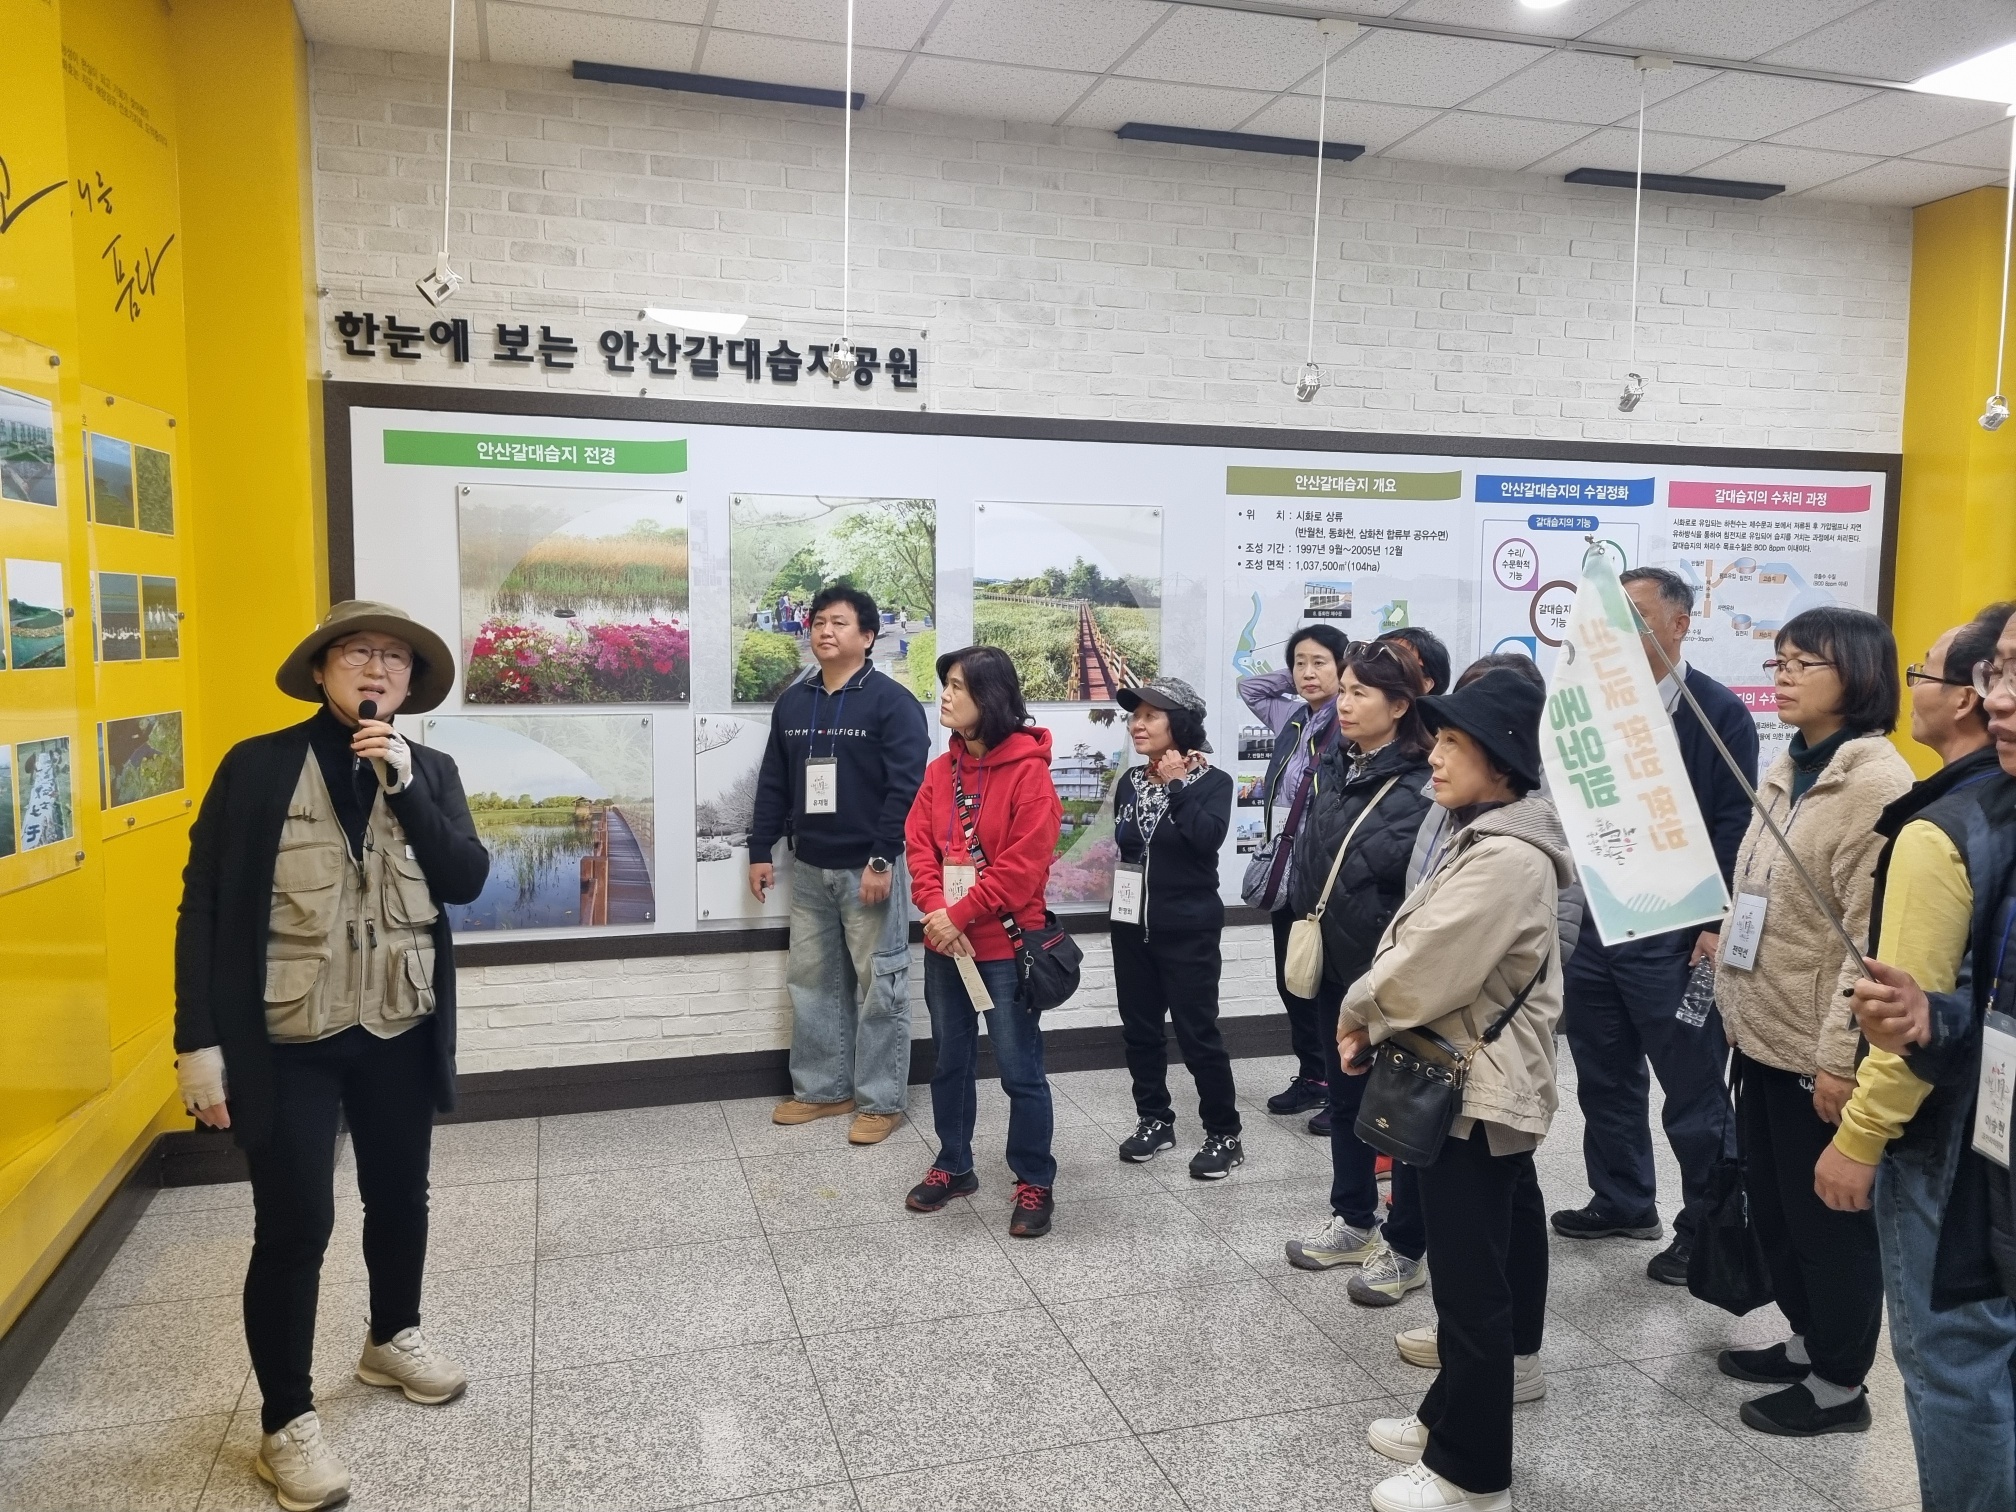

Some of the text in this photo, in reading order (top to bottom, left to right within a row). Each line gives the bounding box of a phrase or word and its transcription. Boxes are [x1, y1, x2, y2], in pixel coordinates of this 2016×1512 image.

[334, 311, 918, 389] 한눈에 보는 안산갈대습지공원
[476, 441, 616, 465] 안산갈대습지 전경
[1295, 475, 1397, 493] 안산갈대습지 개요
[1501, 482, 1629, 500] 안산갈대습지의 수질정화
[1715, 489, 1828, 507] 갈대습지의 수처리 과정
[1246, 509, 1256, 521] 위
[1276, 510, 1285, 522] 치
[1296, 511, 1344, 523] 시화로 상류
[1535, 517, 1592, 528] 갈대습지의 기능
[1698, 519, 1722, 528] 유입되는
[1724, 520, 1747, 529] 하천수는
[1774, 522, 1792, 530] 보에서
[1812, 522, 1818, 531] 후
[1850, 524, 1862, 532] 자연
[1295, 527, 1449, 543] (반월천, 동화천, 삼화천 합류부 공유수면)
[1748, 532, 1772, 541] 유입되어
[1774, 533, 1791, 541] 습지를
[1812, 534, 1835, 542] 과정에서
[1245, 543, 1264, 554] 조성
[1267, 543, 1285, 554] 기간
[1296, 544, 1326, 555] 1997년
[1328, 545, 1381, 557] 9월~2005년
[1384, 546, 1404, 557] 12월
[1507, 548, 1526, 558] 수리/
[1672, 542, 1702, 550] 갈대습지의
[1703, 543, 1721, 551] 처리수
[1768, 544, 1786, 553] 8ppm
[1787, 544, 1812, 553] 이내이다.
[1245, 560, 1264, 571] 조성
[1266, 560, 1286, 571] 면적
[1502, 559, 1530, 570] 수문학적
[1508, 571, 1523, 581] 기능
[1538, 604, 1572, 615] 갈대습지
[1550, 617, 1567, 628] 기능
[785, 728, 867, 737] TOMMY HILFIGER
